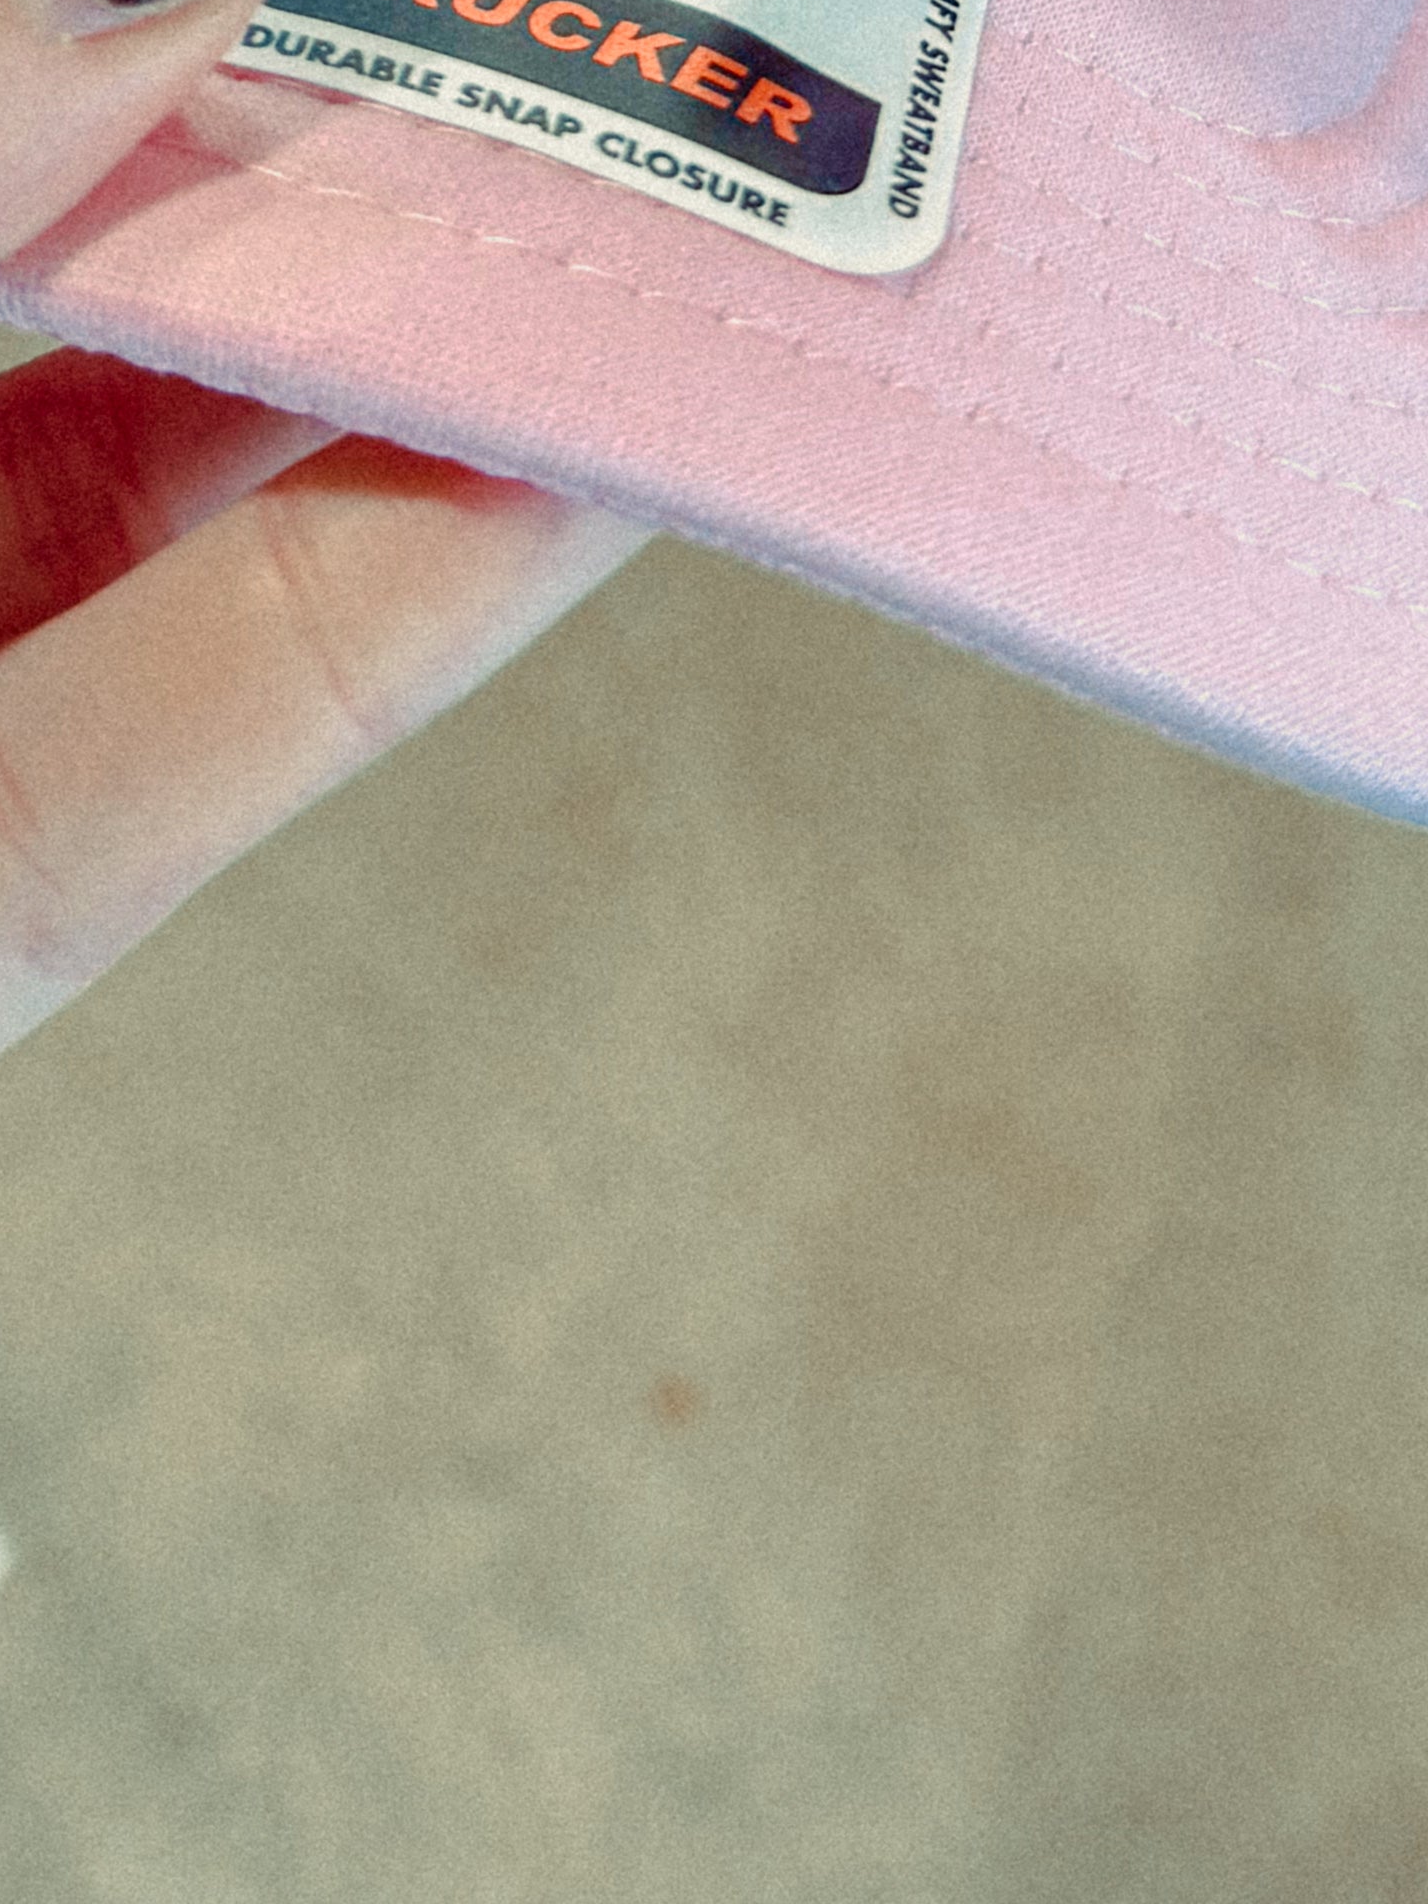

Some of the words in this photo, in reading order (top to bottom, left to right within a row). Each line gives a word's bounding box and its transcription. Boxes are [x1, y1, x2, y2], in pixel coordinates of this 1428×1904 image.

[241, 23, 445, 97] DURABLE
[454, 83, 585, 139] SNAP
[597, 130, 793, 230] CLOSURE
[889, 40, 951, 221] SWEATBAND
